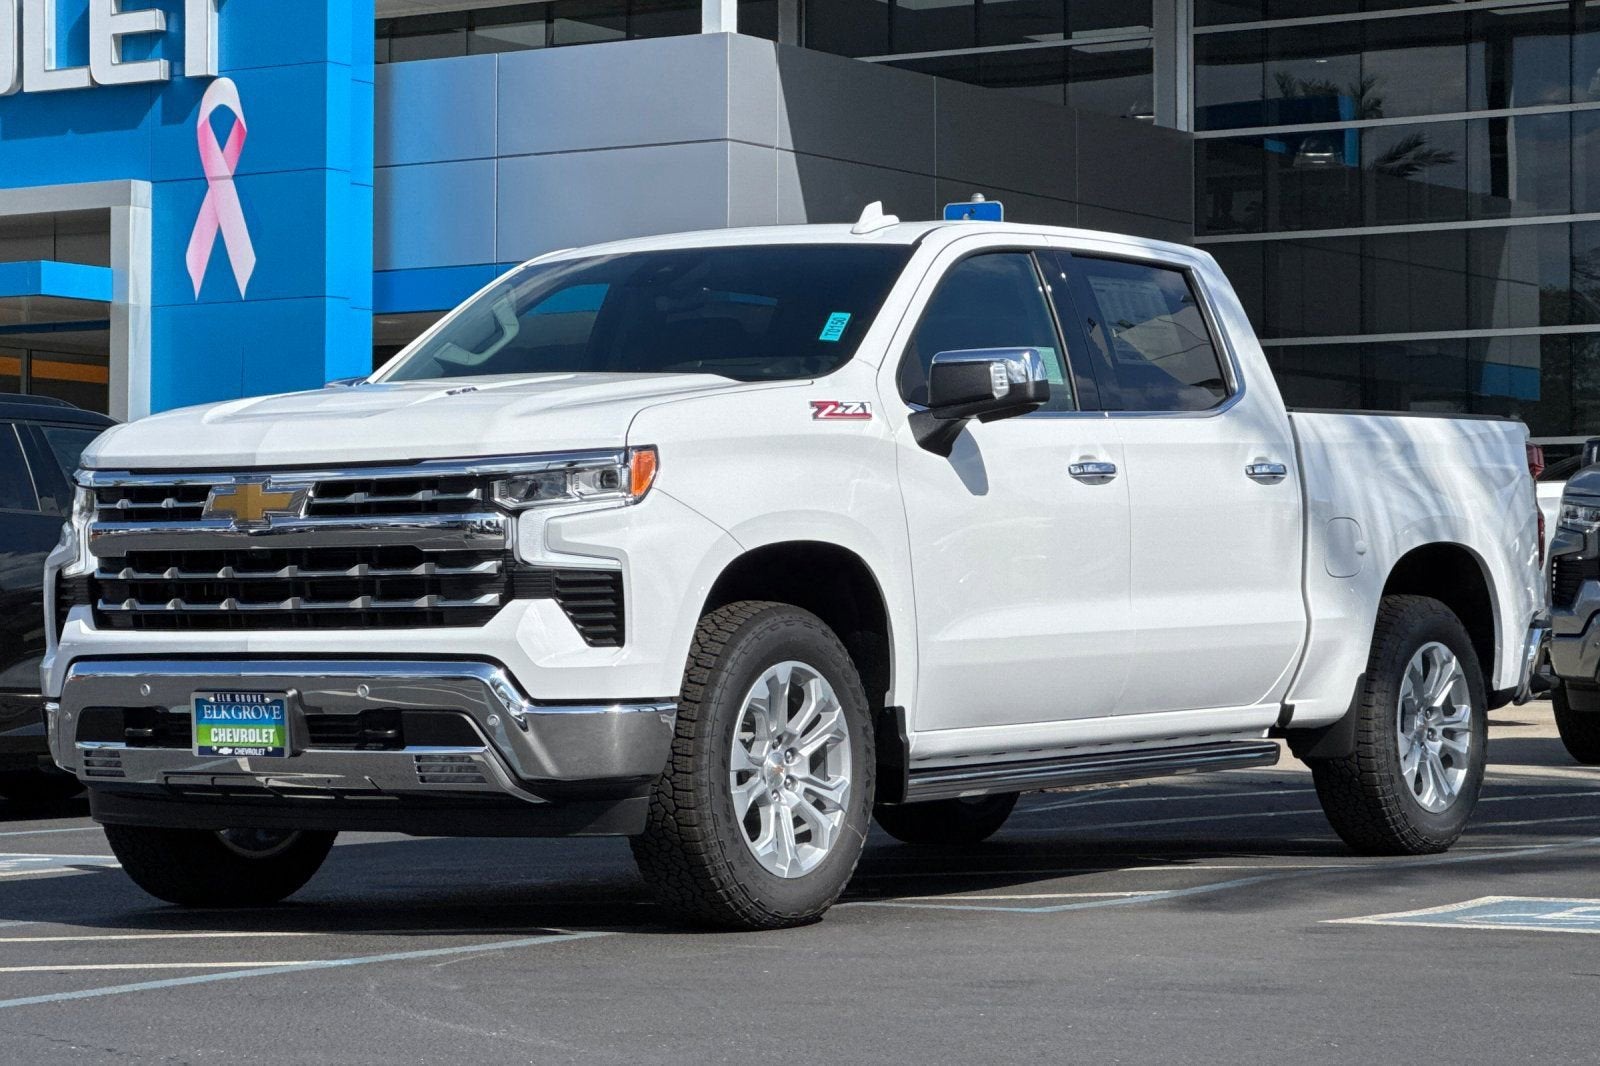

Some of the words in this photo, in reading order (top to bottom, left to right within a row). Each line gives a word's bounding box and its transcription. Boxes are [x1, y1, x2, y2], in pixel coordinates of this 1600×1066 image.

[809, 401, 872, 420] Z71
[216, 693, 231, 702] ELK
[235, 694, 262, 703] GROVE
[211, 728, 275, 743] CHEVROLET
[234, 747, 266, 756] CHEVROLET
